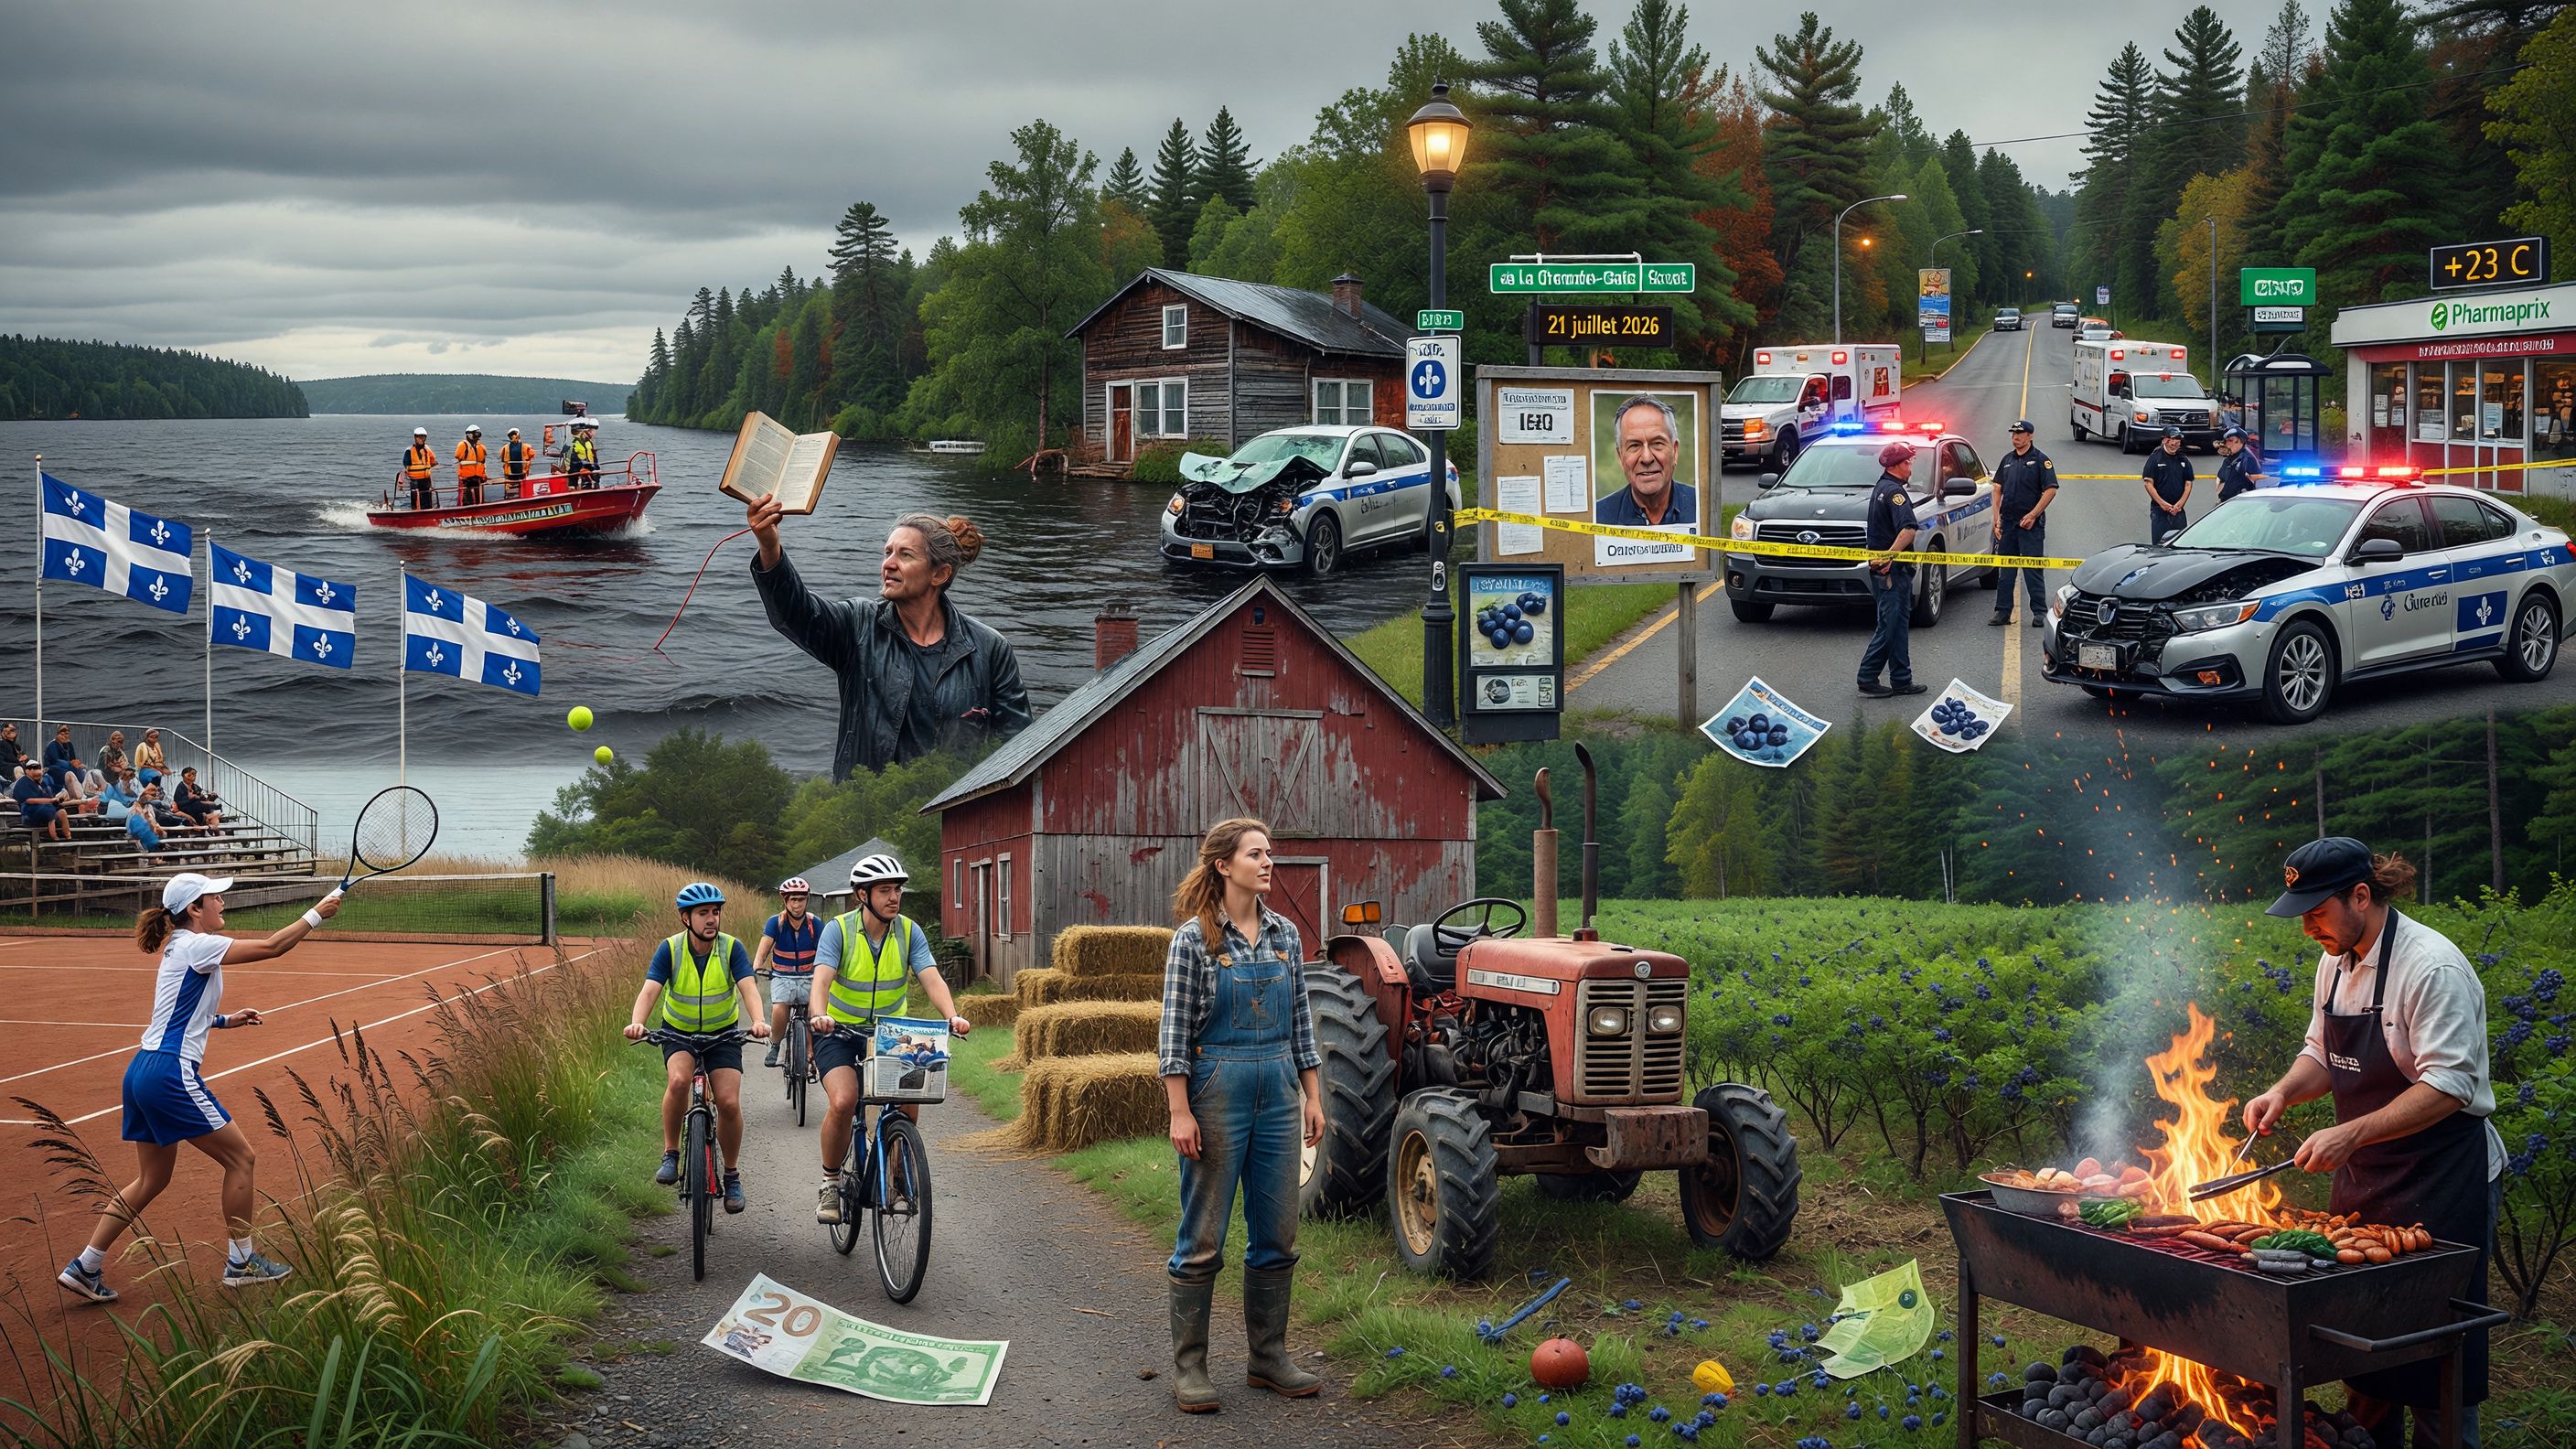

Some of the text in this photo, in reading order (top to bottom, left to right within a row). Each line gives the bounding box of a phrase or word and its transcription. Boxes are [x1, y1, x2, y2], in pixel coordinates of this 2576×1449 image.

[2444, 244, 2530, 281] +23 C
[1548, 315, 1659, 339] 21 juillet 2026
[2452, 297, 2550, 326] Pharmaprix
[743, 1292, 821, 1337] 20
